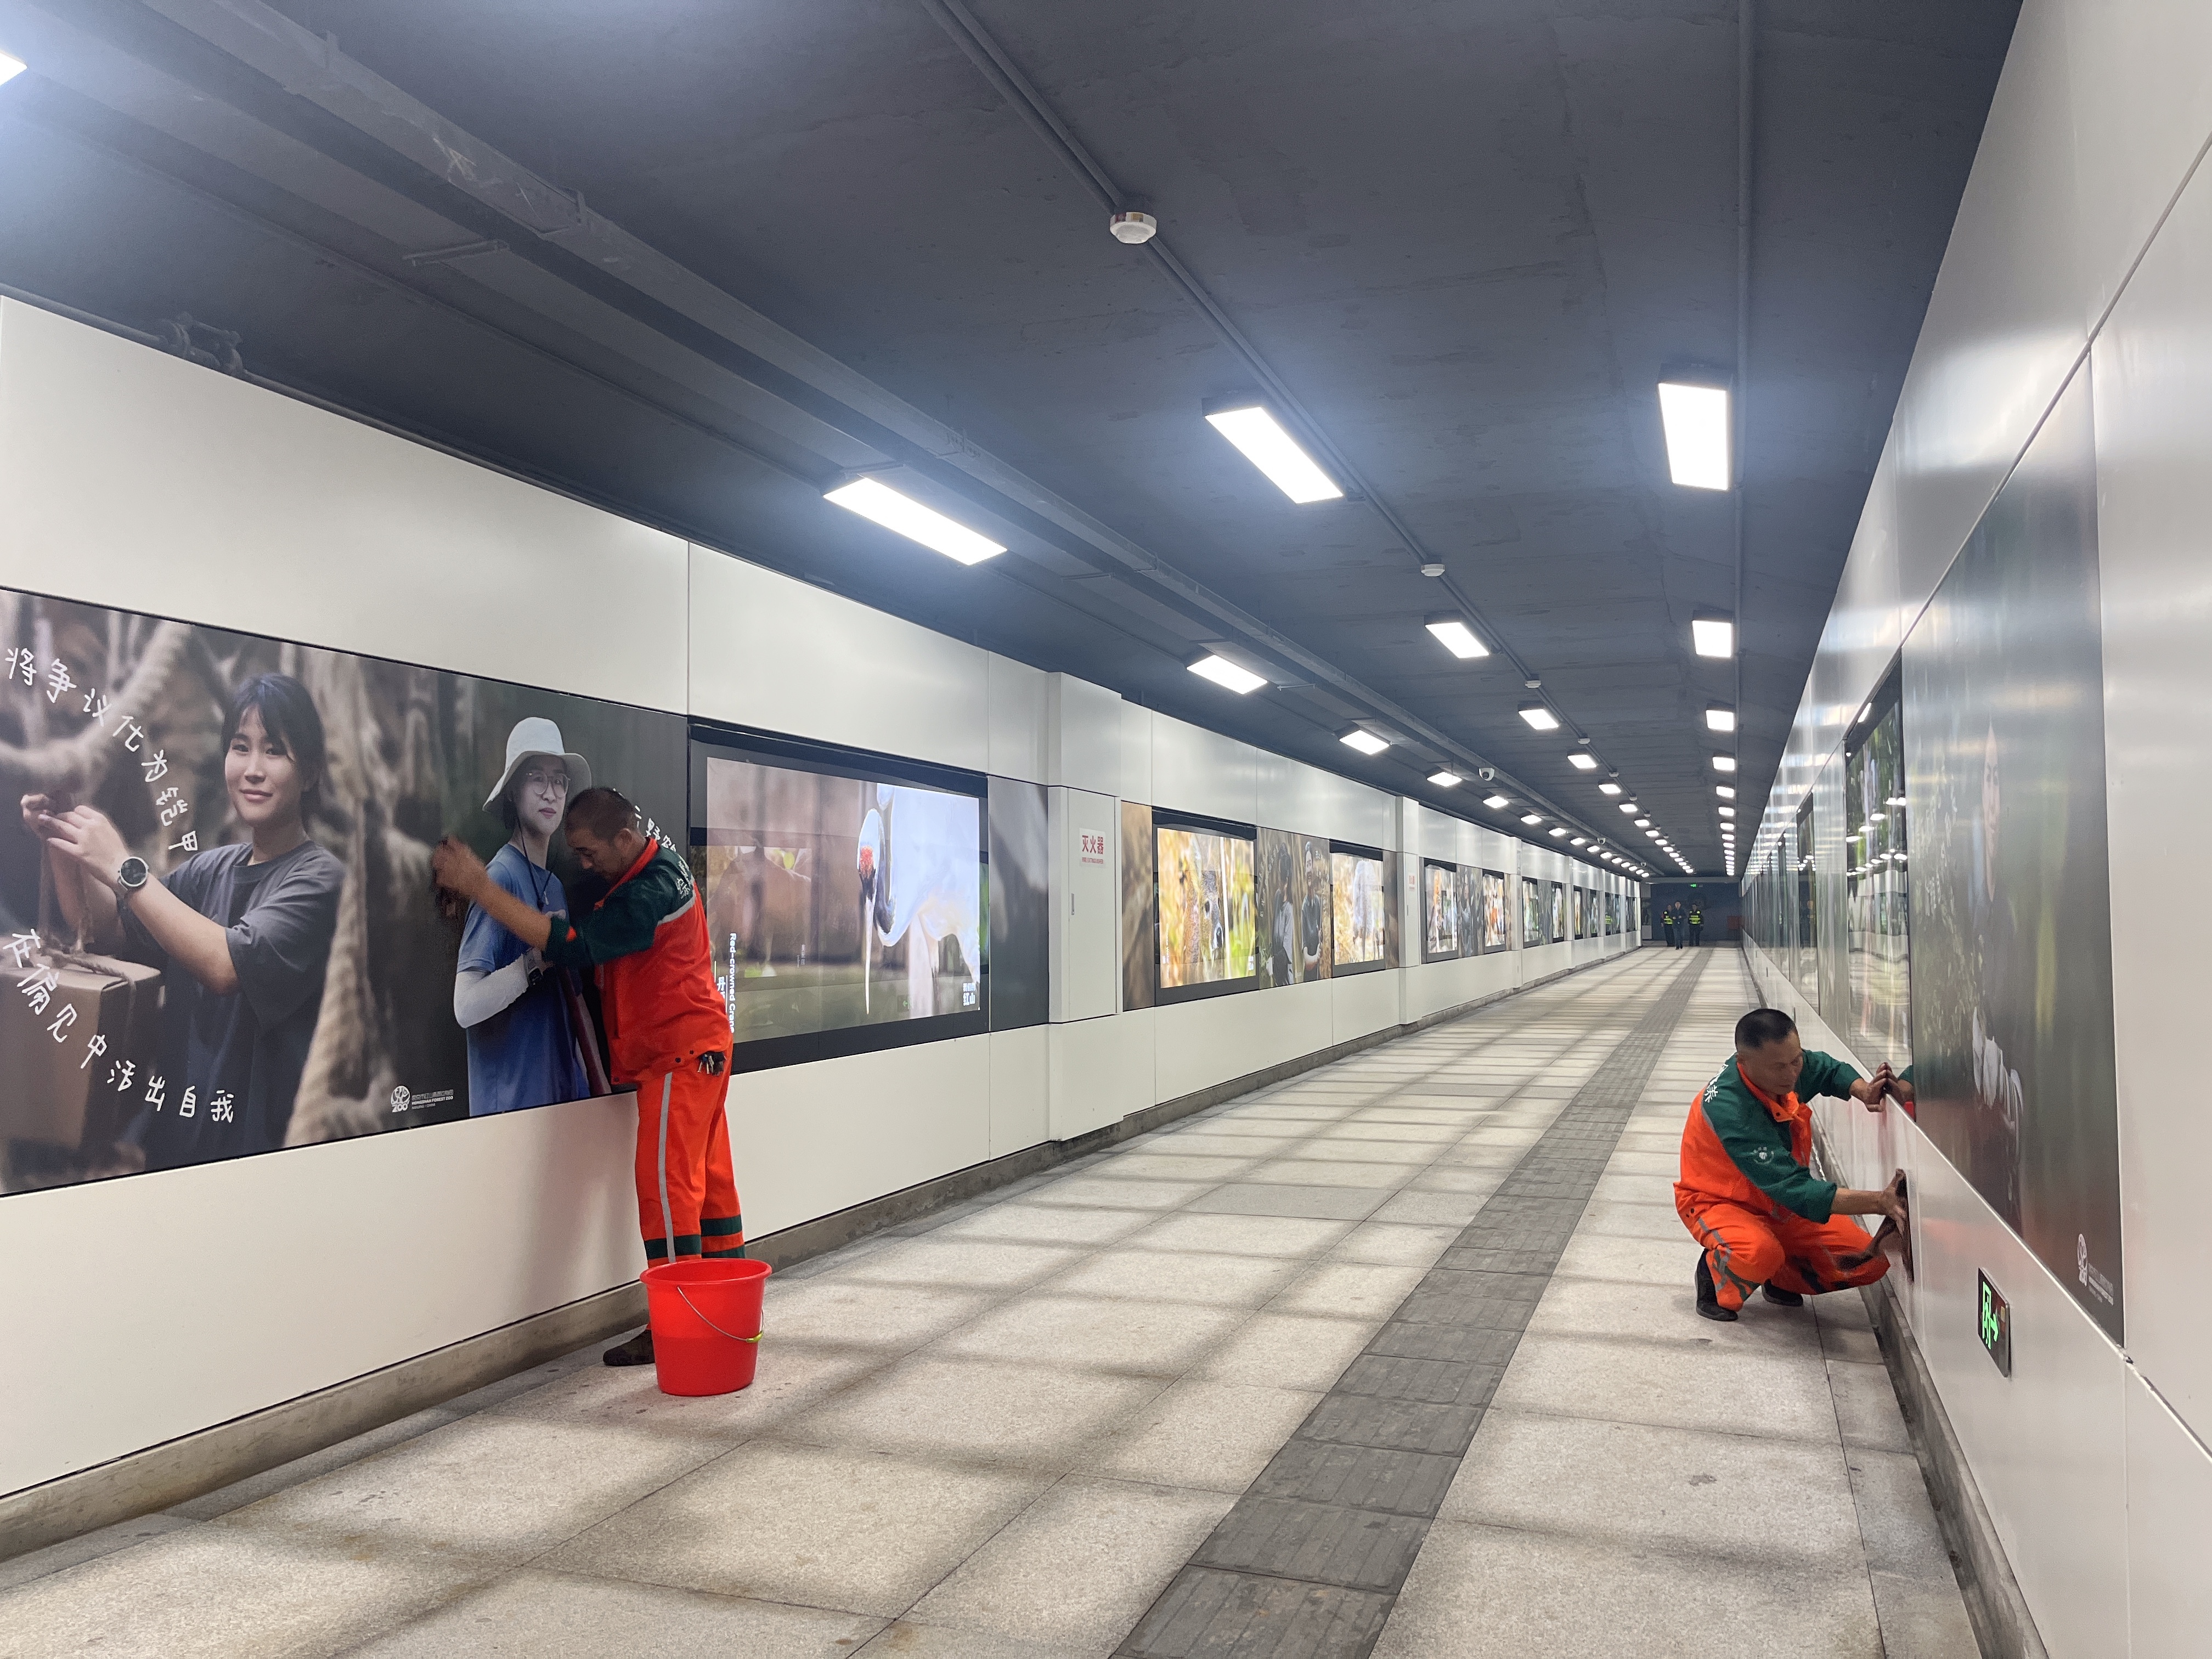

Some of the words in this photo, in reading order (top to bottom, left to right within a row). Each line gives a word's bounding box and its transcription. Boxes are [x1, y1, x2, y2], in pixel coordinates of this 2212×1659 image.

[5, 647, 199, 851] 将争议化为铠甲
[1082, 835, 1104, 854] 灭火器
[963, 992, 975, 1006] 红山
[3, 929, 234, 1123] 在偏见中活出自我
[392, 1103, 408, 1113] ZOO
